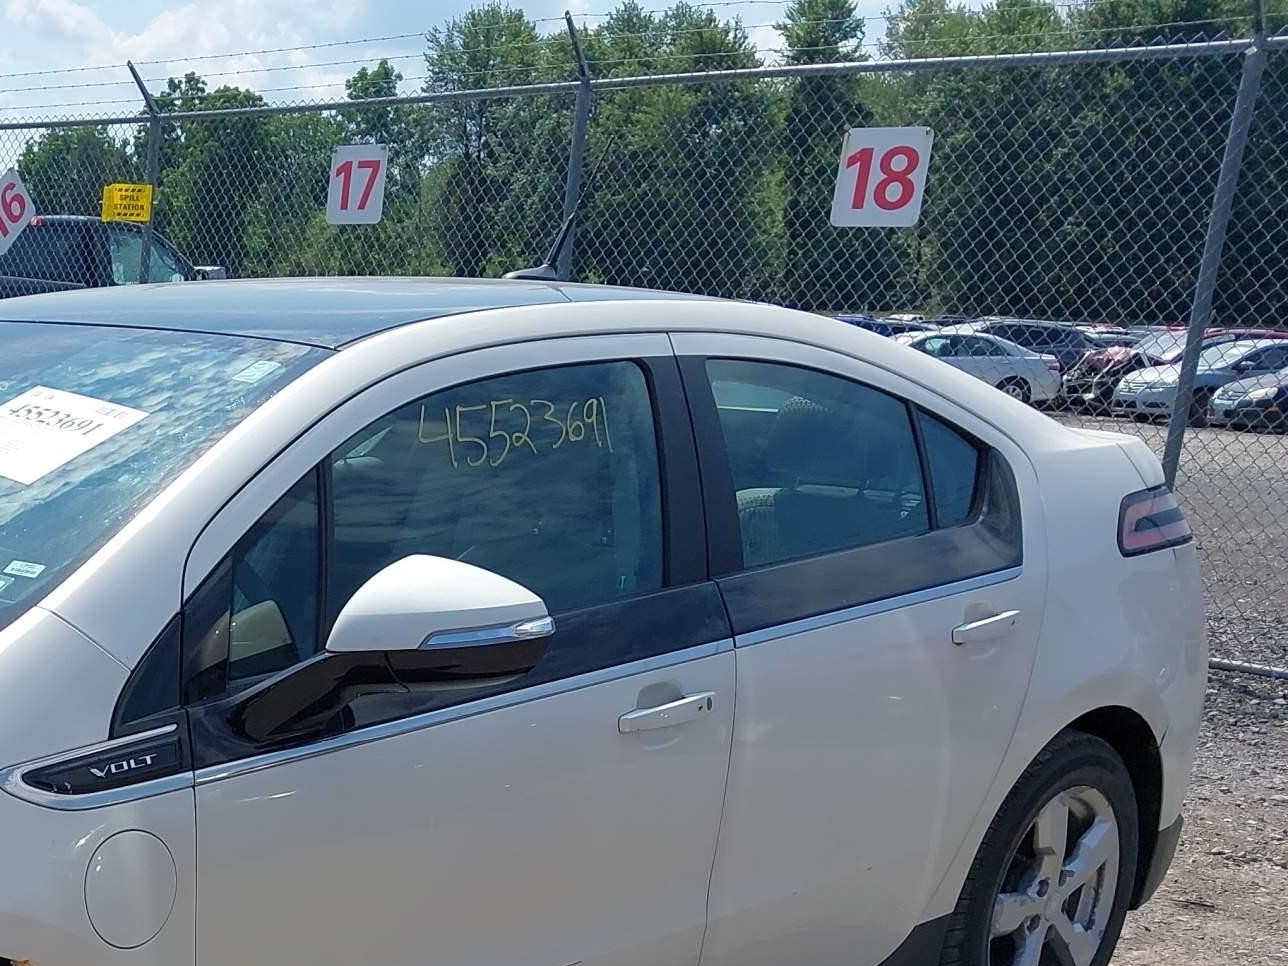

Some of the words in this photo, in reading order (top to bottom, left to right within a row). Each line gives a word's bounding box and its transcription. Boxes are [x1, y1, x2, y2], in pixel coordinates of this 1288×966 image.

[334, 159, 382, 210] 17
[845, 144, 920, 211] 18
[112, 203, 145, 212] STATION
[118, 193, 141, 202] SPILL
[8, 403, 104, 436] 45523691
[418, 397, 613, 470] 45523691
[88, 753, 158, 778] VOLT
